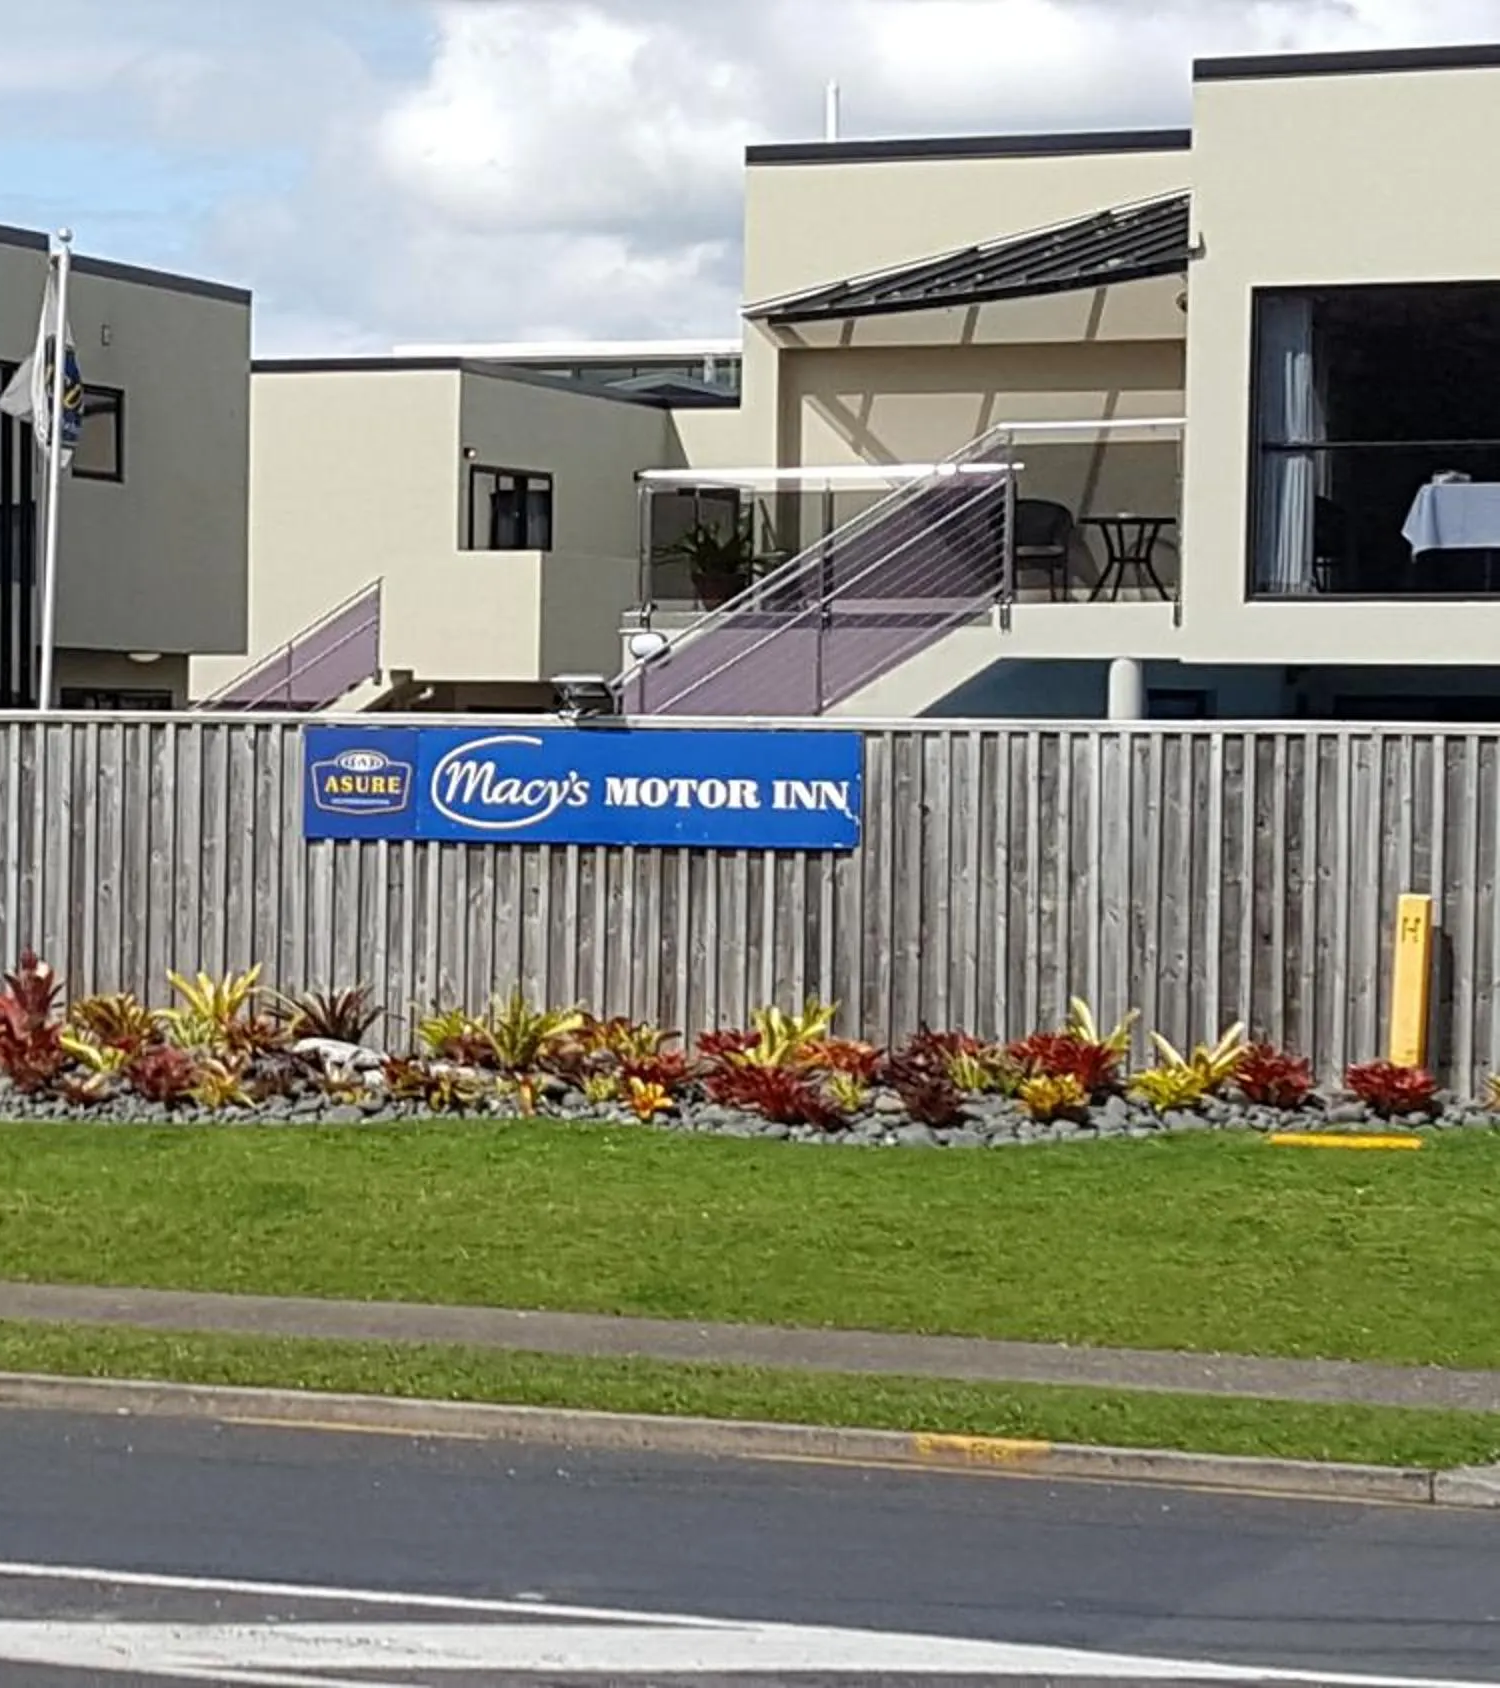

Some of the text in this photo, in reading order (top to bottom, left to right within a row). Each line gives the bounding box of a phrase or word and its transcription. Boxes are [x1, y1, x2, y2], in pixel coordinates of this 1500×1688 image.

[324, 775, 402, 795] ASURE
[445, 759, 850, 829] Macy's MOTOR INN
